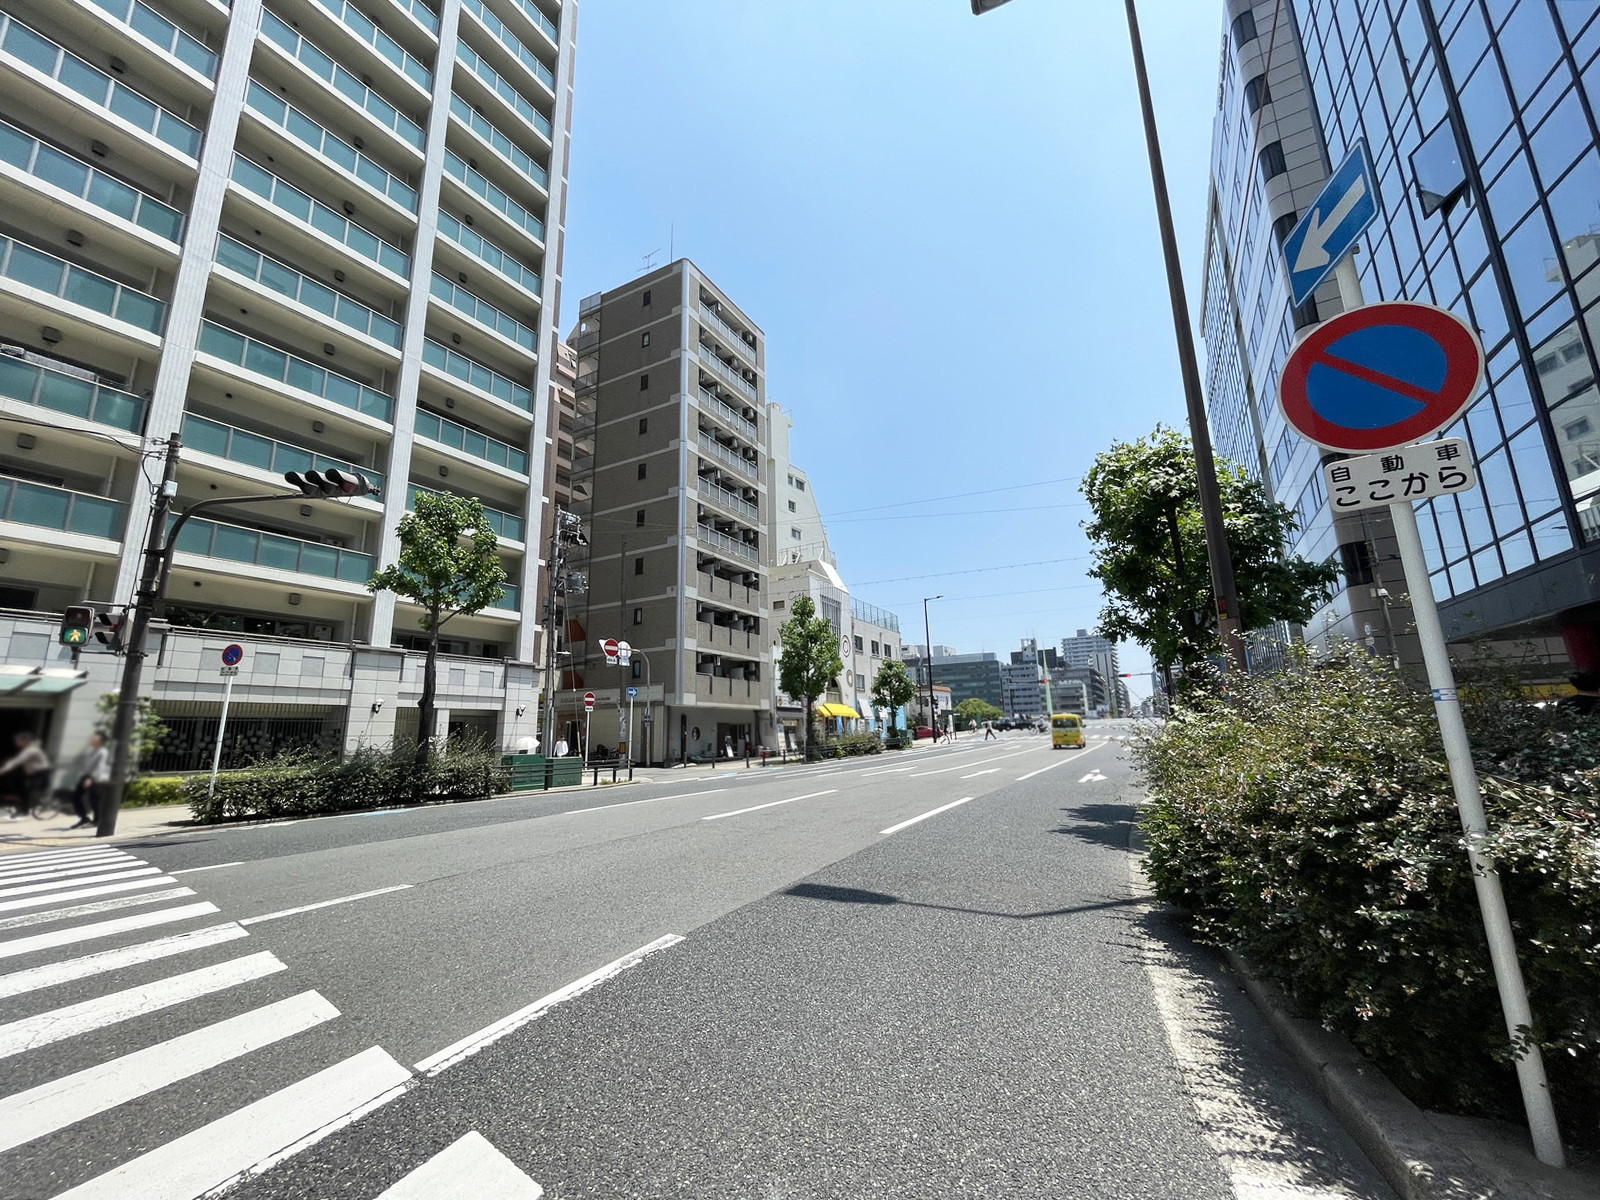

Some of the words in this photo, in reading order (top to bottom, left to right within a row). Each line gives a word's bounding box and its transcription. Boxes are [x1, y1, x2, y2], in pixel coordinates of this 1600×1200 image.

[1330, 443, 1461, 483] 自動車
[1336, 466, 1467, 507] ここから
